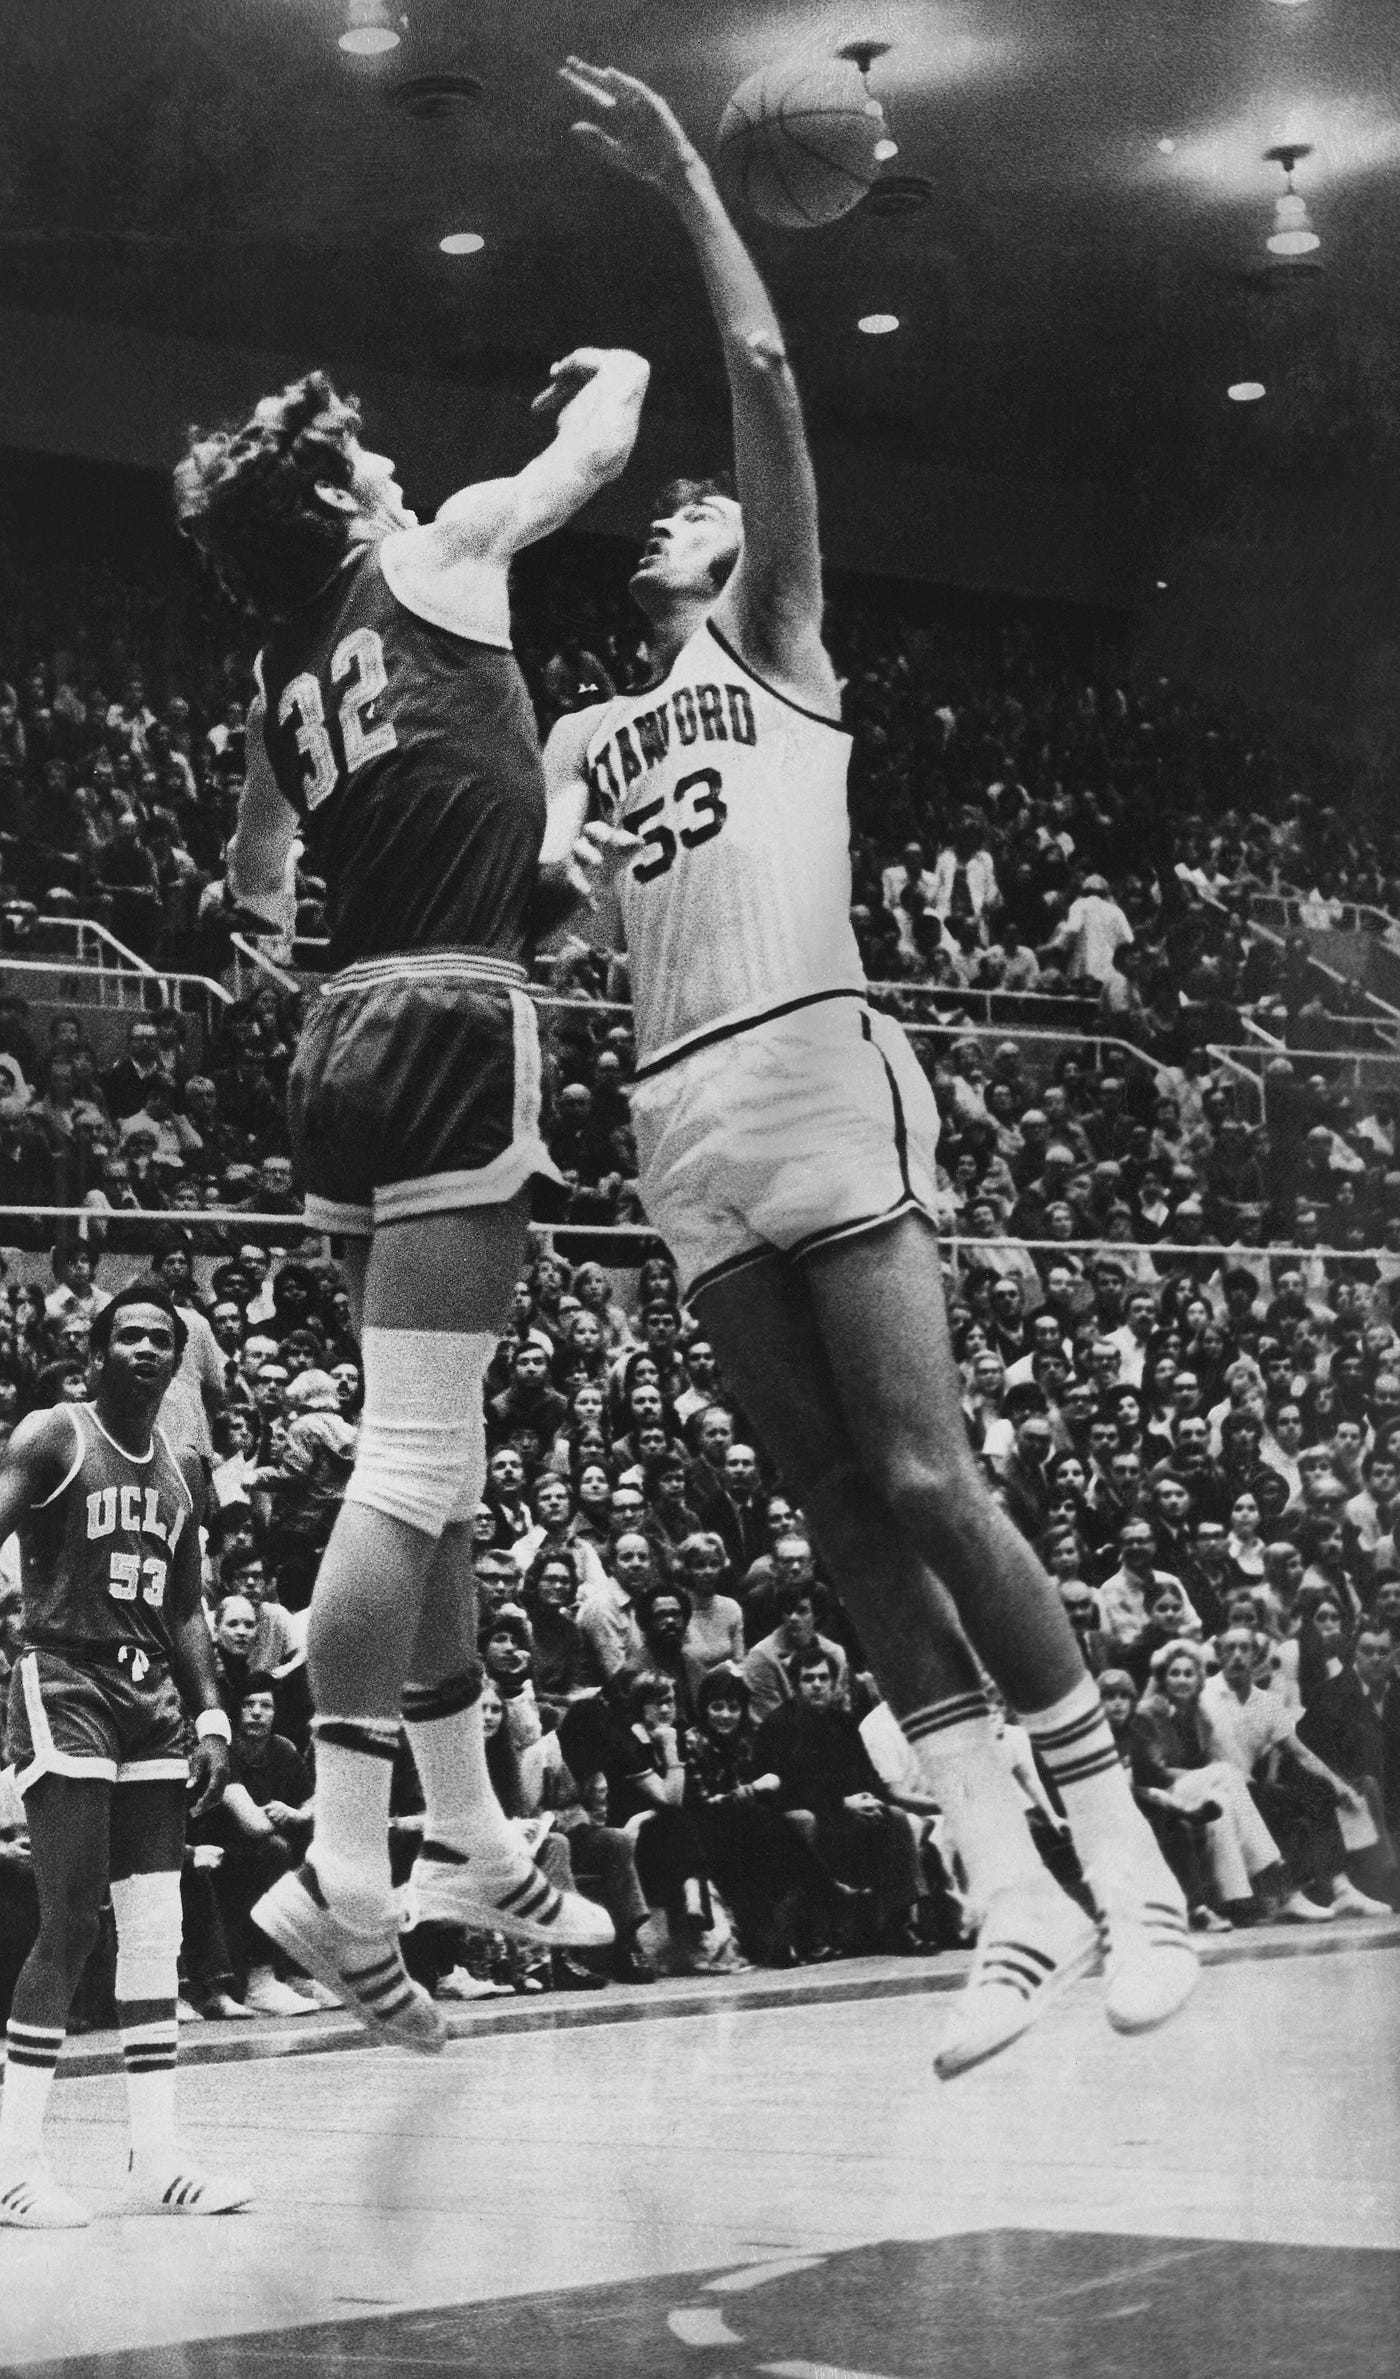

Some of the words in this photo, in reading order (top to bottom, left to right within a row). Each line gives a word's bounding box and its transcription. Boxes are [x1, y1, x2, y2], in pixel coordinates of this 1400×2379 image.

[278, 626, 399, 811] 32
[621, 767, 728, 885] 53
[108, 1551, 168, 1607] 53
